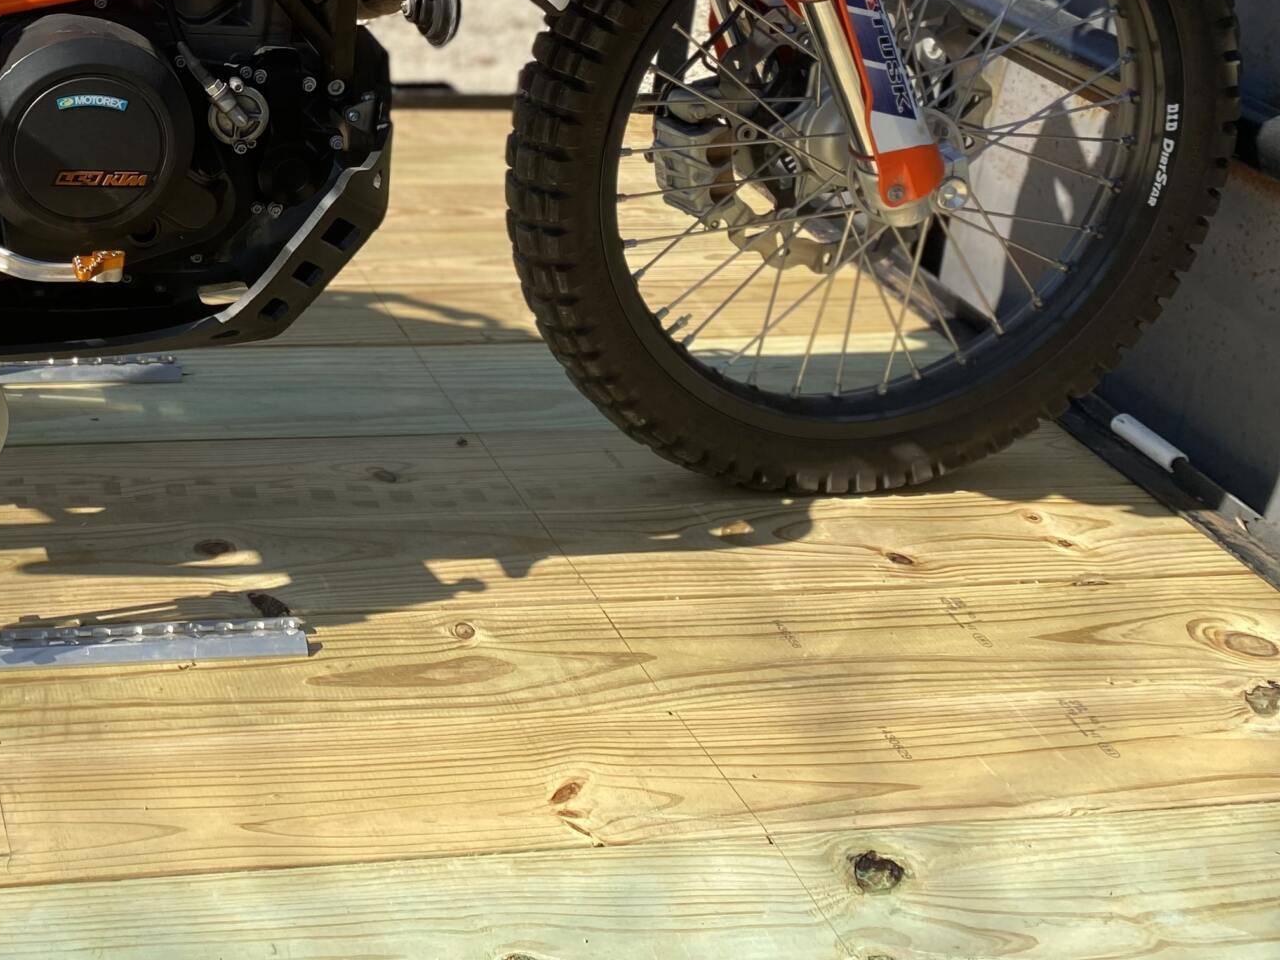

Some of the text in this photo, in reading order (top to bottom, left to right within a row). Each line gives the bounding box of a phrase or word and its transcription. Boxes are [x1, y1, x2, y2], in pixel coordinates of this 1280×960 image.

[872, 16, 914, 115] TUSK
[75, 95, 123, 110] MOTOREX
[102, 171, 147, 186] KTM
